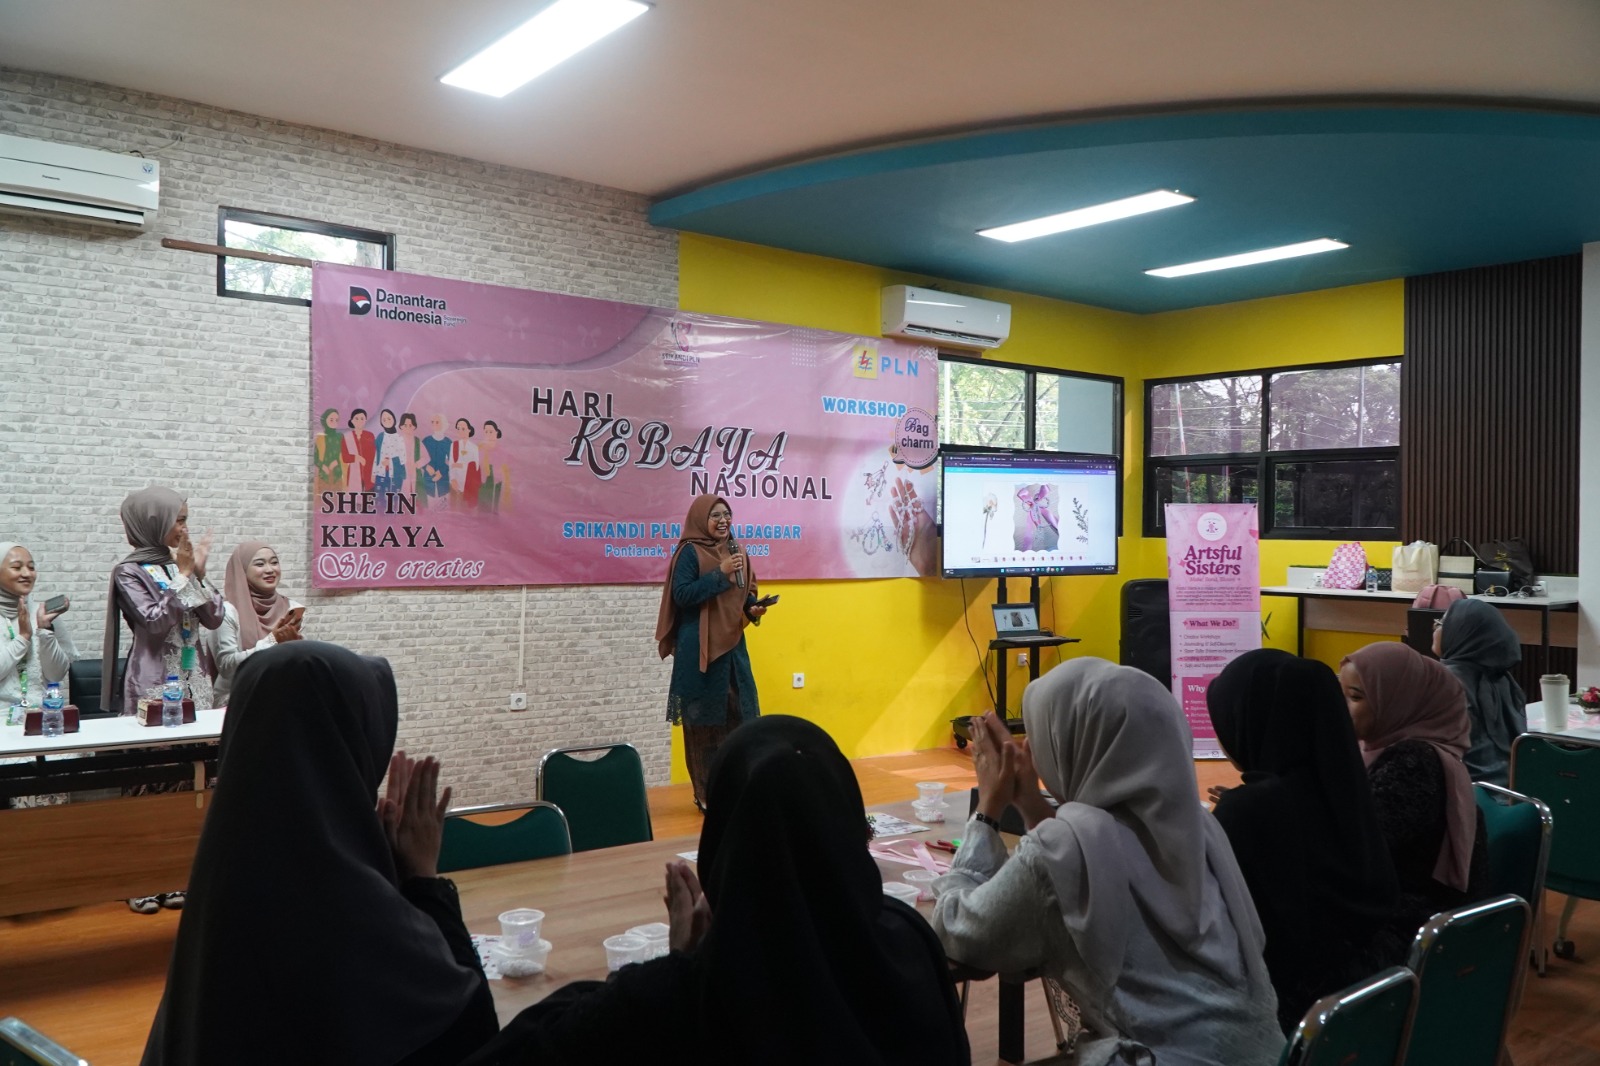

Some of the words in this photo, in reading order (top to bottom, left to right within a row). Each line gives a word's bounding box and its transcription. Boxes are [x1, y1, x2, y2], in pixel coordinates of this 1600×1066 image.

[376, 288, 446, 310] Danantara
[376, 304, 442, 325] Indonesia
[881, 356, 919, 377] PLN
[532, 387, 613, 418] HARI
[822, 396, 907, 418] WORKSHOP
[904, 417, 930, 437] Bag
[563, 416, 789, 480] KEBAYA
[901, 435, 934, 449] charm
[691, 471, 833, 500] NASIONAL
[321, 491, 377, 514] SHE
[385, 492, 417, 515] IN
[321, 525, 445, 548] KEBAYA
[562, 521, 645, 540] SRIKANDI
[651, 522, 681, 540] PLN
[746, 544, 770, 556] 2025
[1184, 544, 1243, 563] Artsful
[318, 553, 386, 580] She
[396, 558, 485, 579] creates
[1185, 560, 1241, 575] Sisters
[1187, 684, 1206, 694] Why
